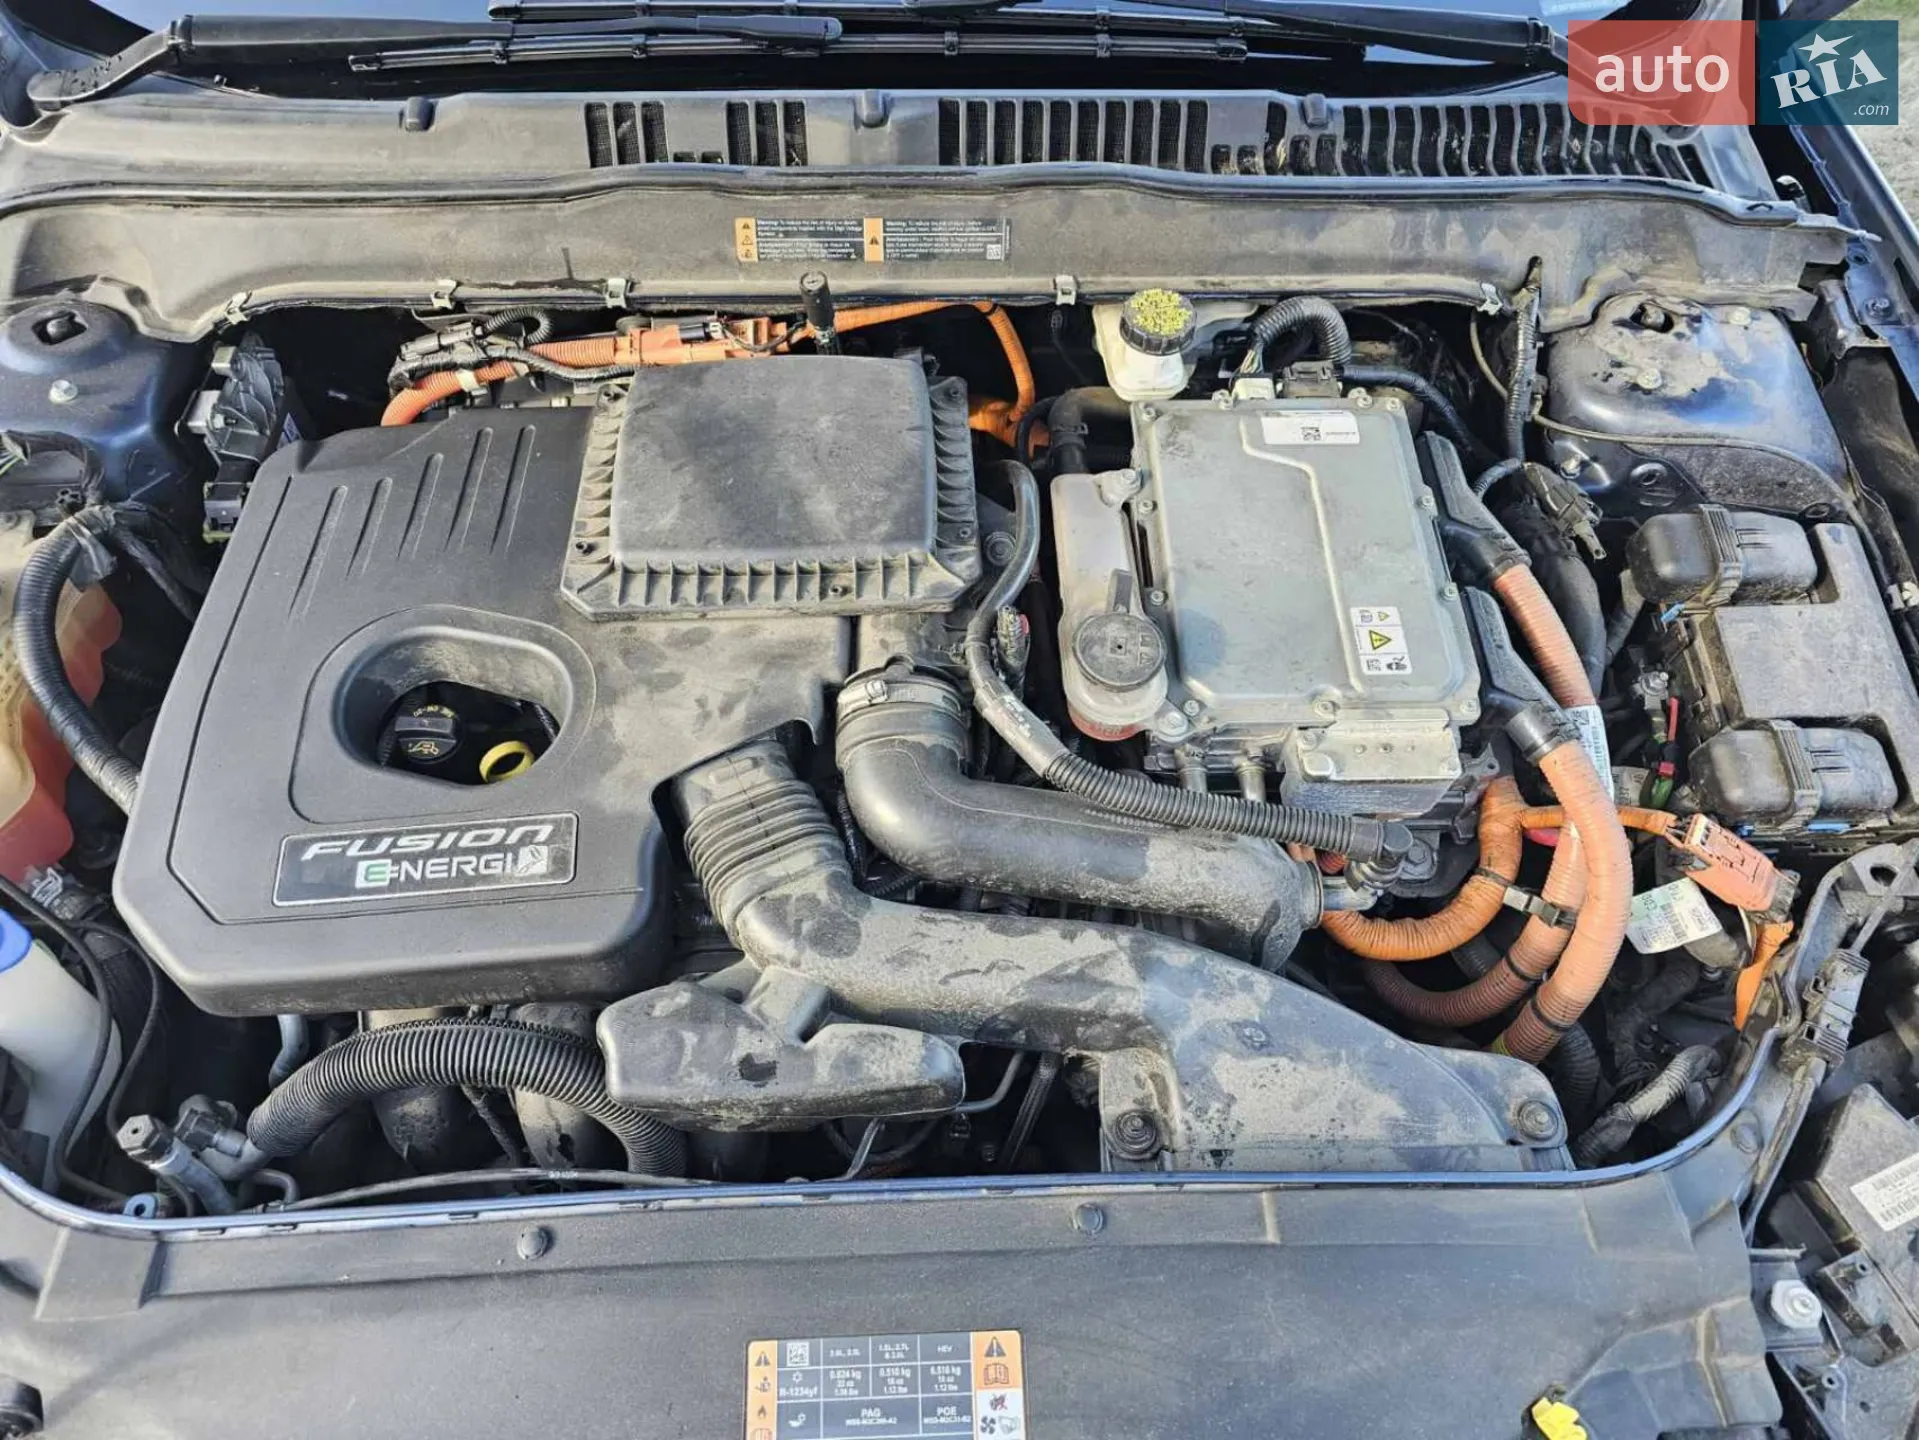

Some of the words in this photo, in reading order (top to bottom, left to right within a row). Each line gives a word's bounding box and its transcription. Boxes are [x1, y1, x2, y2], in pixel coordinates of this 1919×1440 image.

[300, 824, 555, 862] FUSION
[861, 1408, 882, 1418] PAG
[937, 1406, 958, 1416] POE
